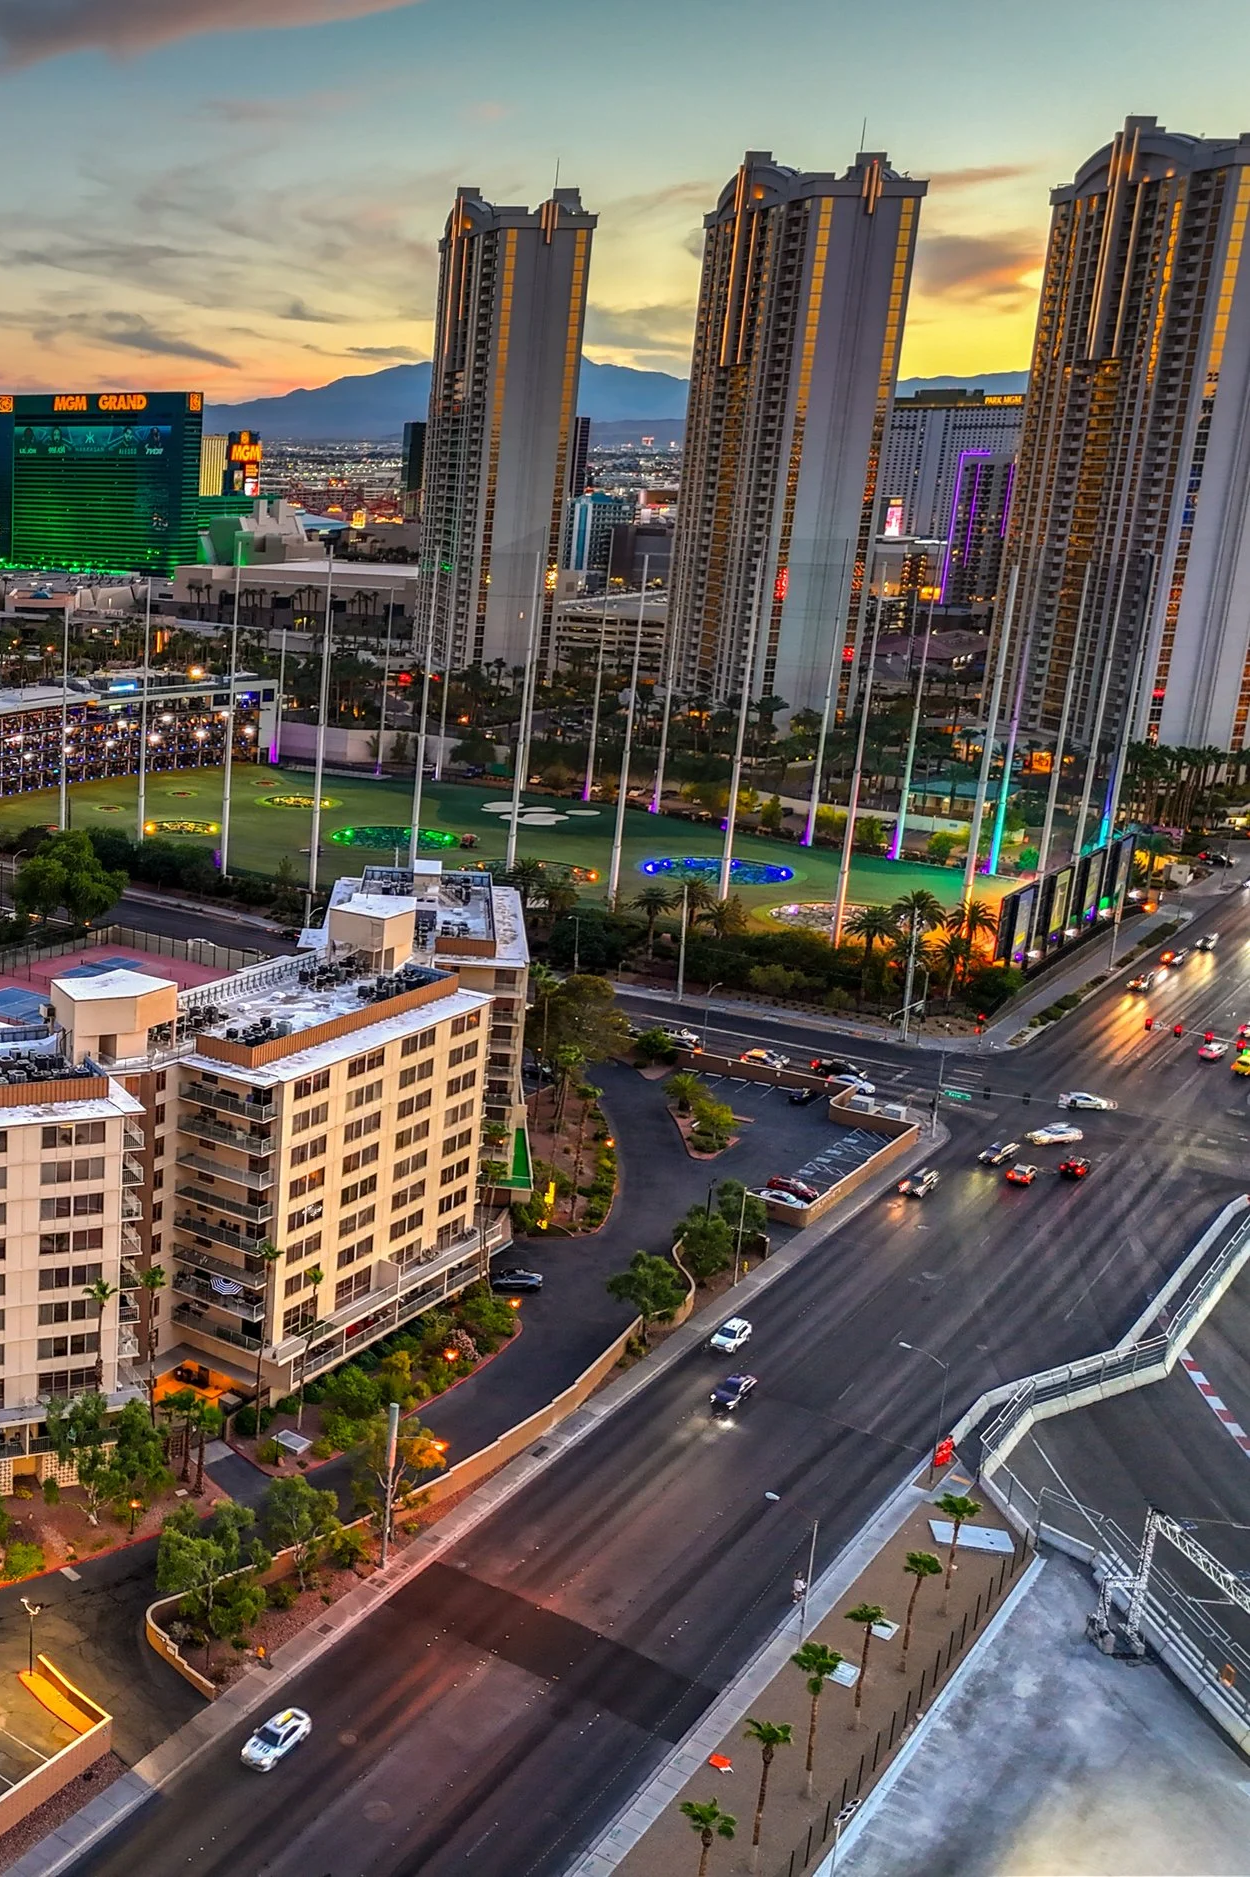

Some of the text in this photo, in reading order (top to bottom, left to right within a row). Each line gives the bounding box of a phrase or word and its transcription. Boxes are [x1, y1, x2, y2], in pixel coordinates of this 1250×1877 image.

[53, 394, 147, 411] MGM GRAND
[984, 395, 1023, 405] PARK MGM
[231, 444, 261, 461] MGM
